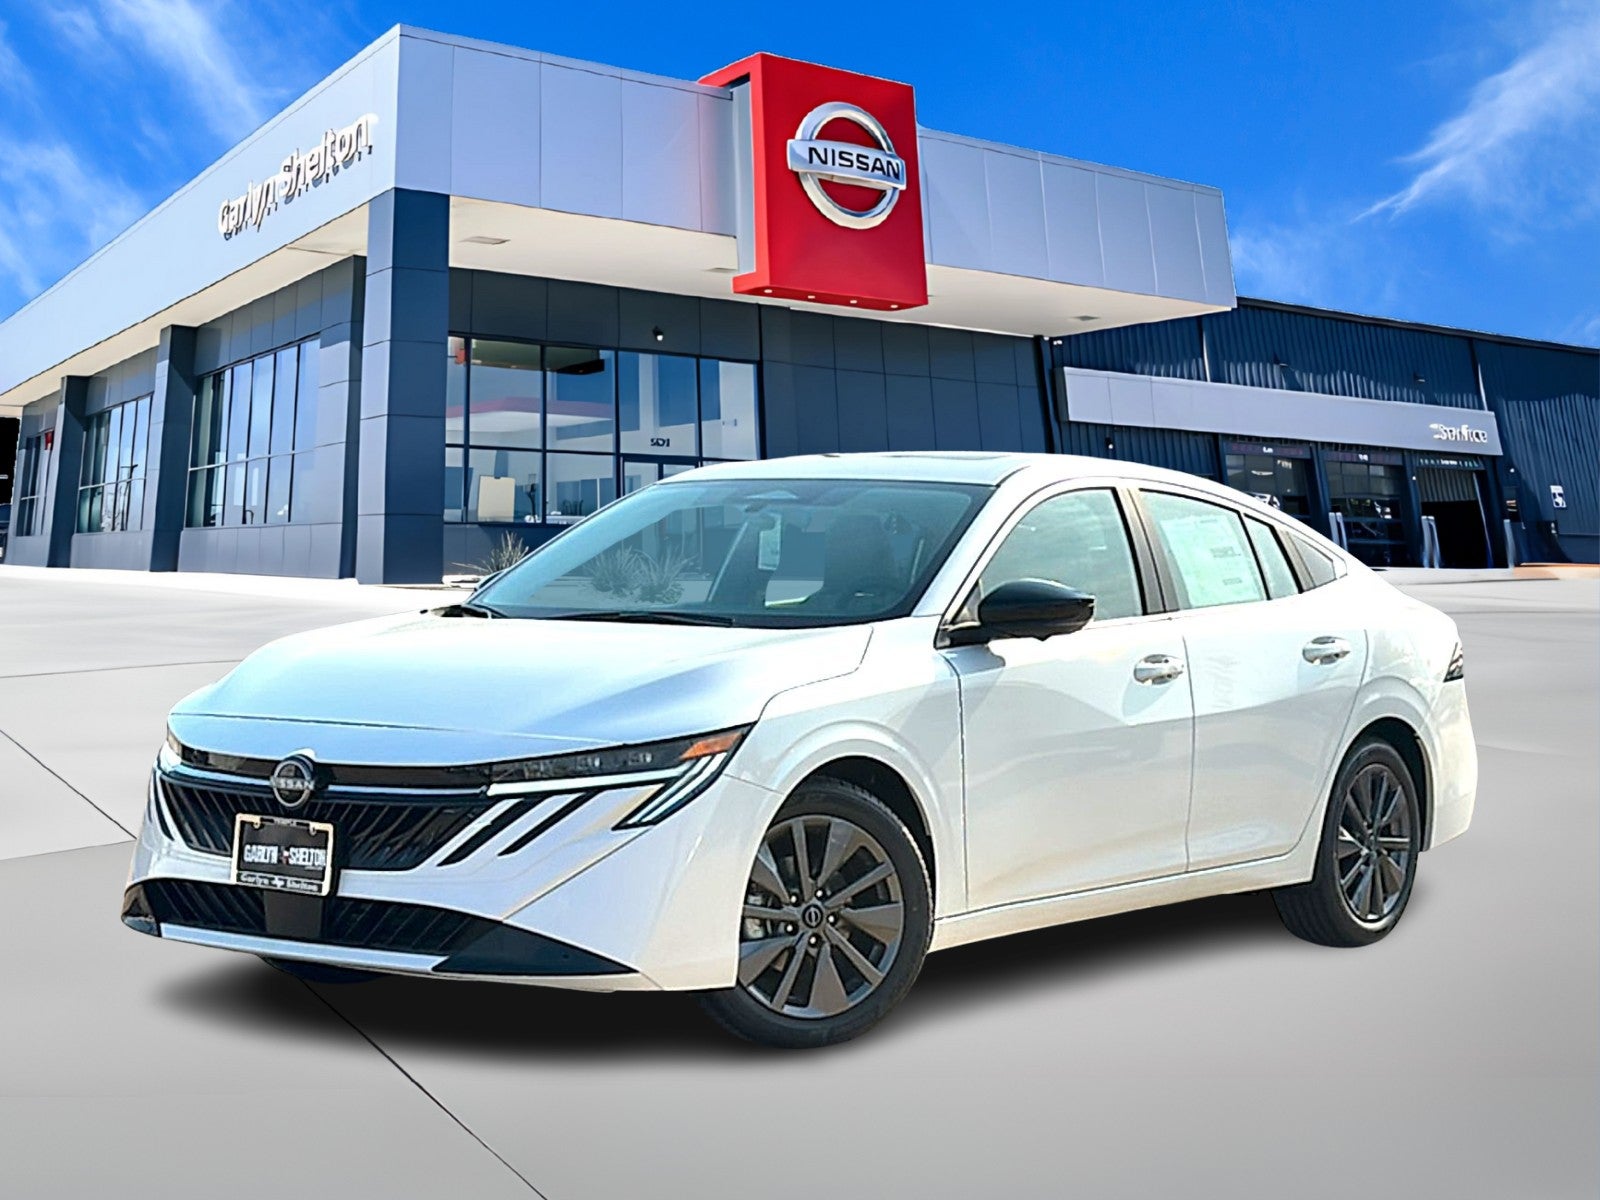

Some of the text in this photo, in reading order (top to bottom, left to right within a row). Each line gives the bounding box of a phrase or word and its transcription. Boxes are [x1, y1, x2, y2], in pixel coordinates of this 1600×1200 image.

[218, 116, 374, 237] Garlyn Shelton
[808, 147, 900, 180] NISSAN
